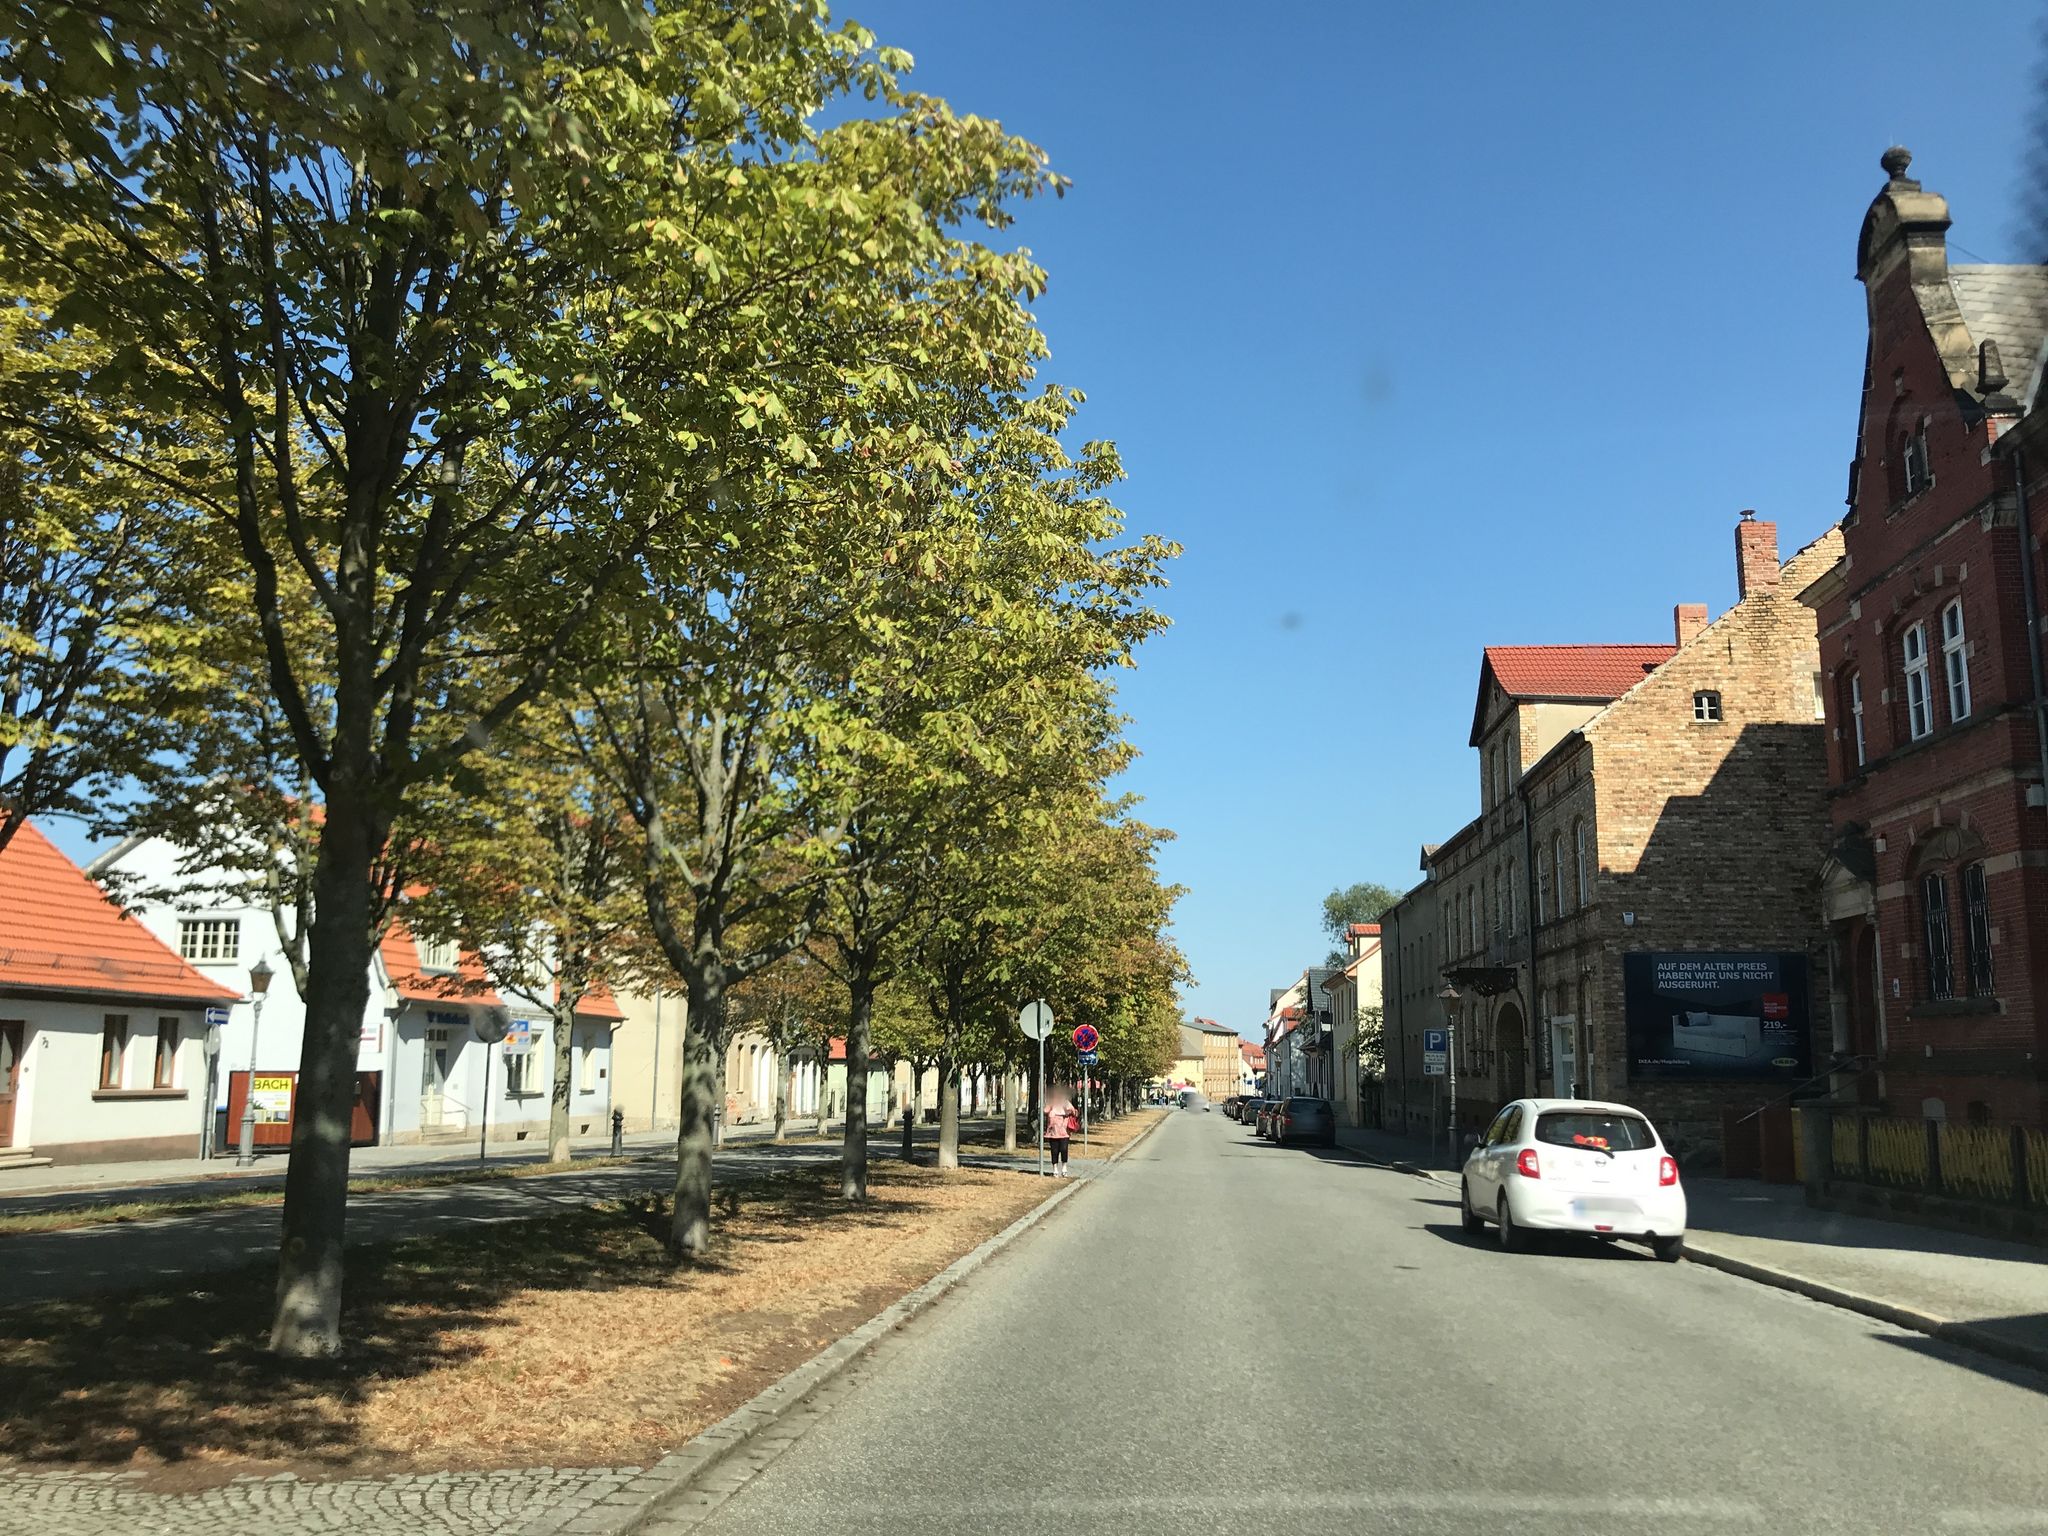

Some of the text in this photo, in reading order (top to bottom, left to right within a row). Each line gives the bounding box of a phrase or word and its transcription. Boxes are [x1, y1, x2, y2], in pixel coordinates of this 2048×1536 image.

[1657, 962, 1767, 971] AUF DEM ALTEN PREIS
[1658, 971, 1774, 980] HABEN WIR UNS NICHT
[1658, 980, 1720, 989] AUSGERUHT.
[1763, 1020, 1788, 1029] 219.-
[1430, 1032, 1442, 1049] P
